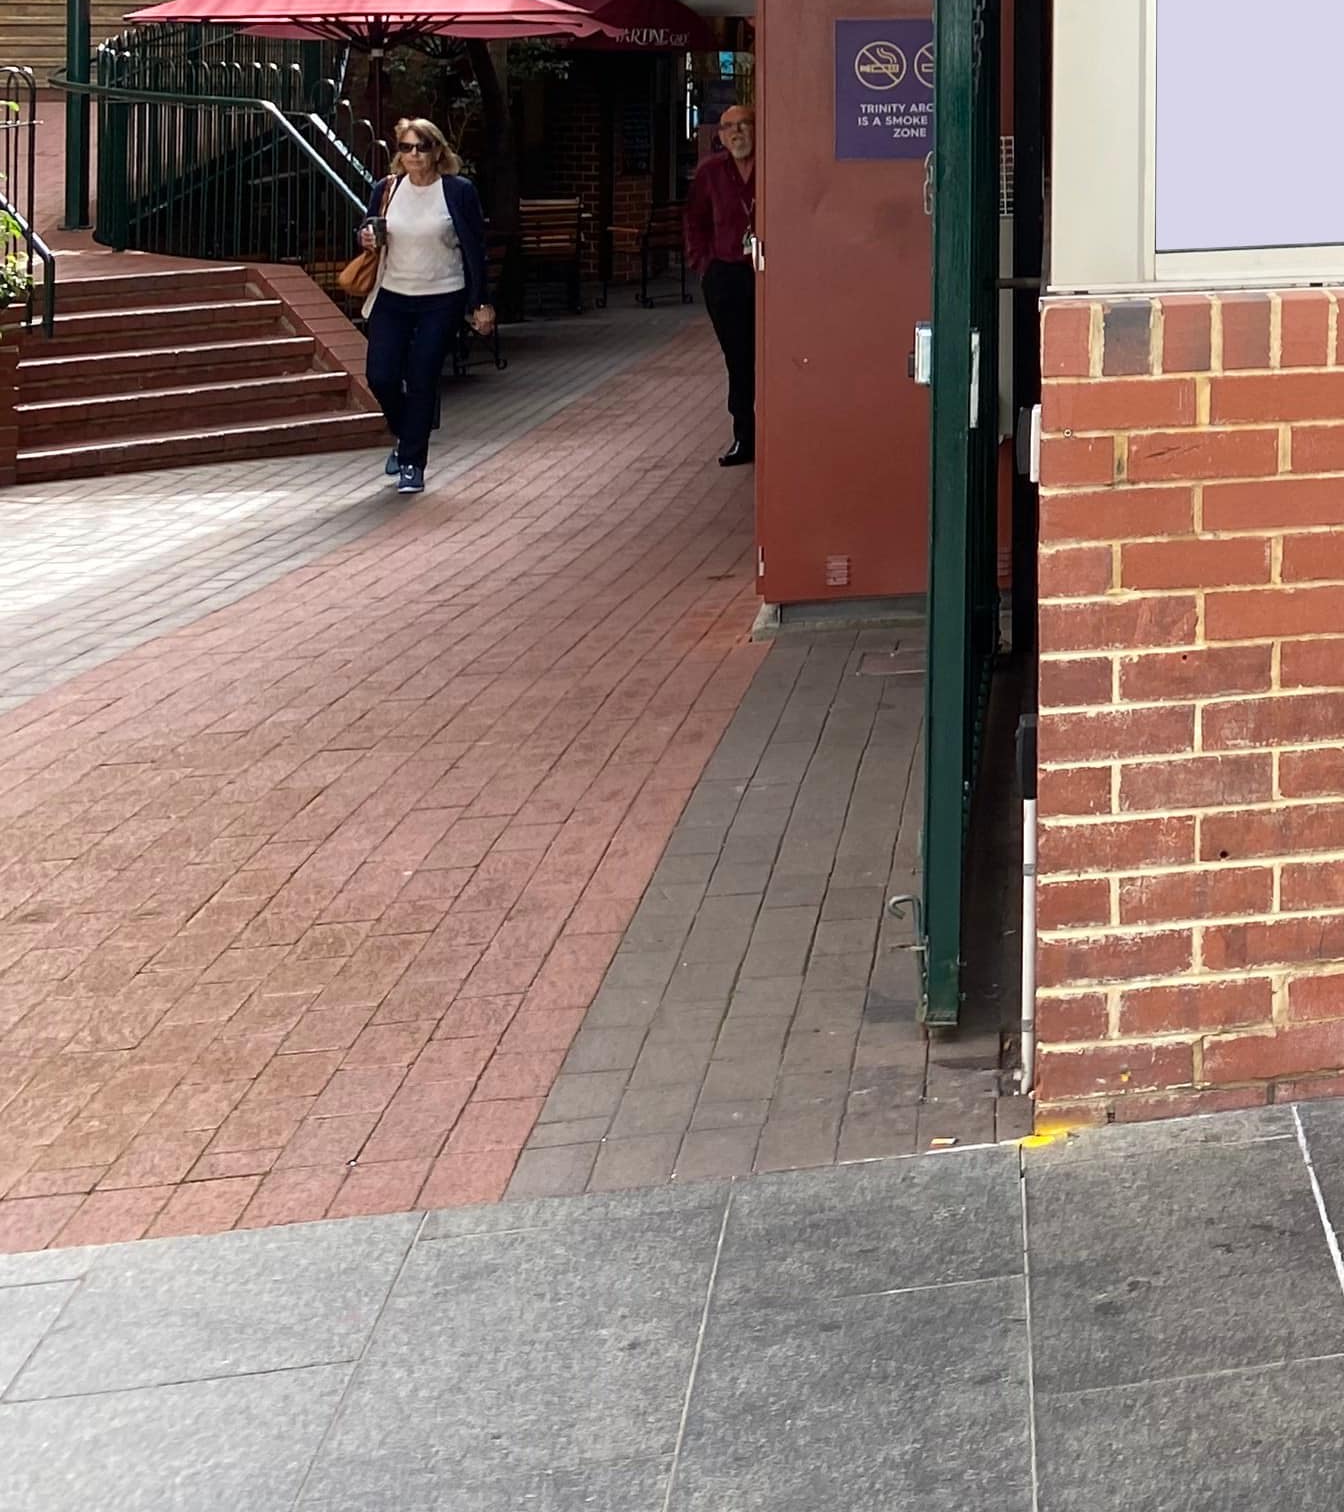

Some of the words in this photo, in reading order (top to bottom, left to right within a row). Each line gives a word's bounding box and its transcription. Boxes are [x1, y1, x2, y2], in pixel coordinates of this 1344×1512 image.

[860, 103, 906, 113] TRINITY
[858, 116, 869, 126] IS
[872, 116, 882, 126] A
[885, 116, 928, 125] SMOKE
[893, 128, 927, 138] ZONE
